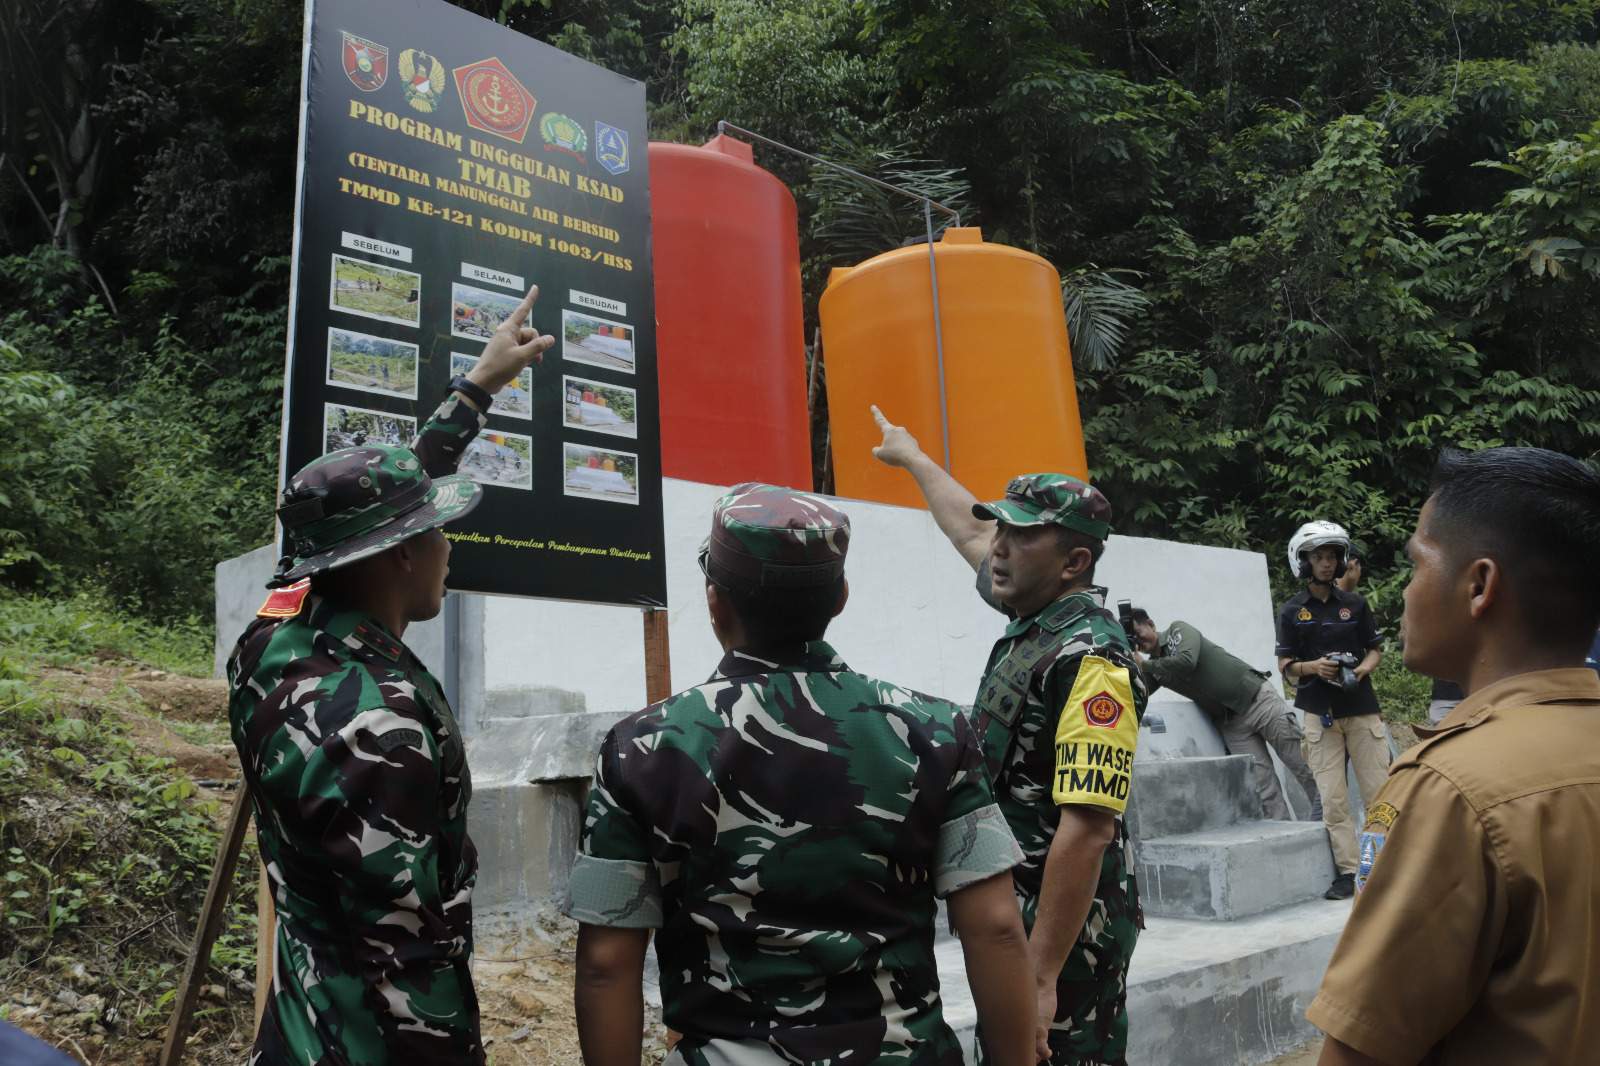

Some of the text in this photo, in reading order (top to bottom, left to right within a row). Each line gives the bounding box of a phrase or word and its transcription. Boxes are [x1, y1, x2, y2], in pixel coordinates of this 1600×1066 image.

[349, 99, 624, 204] PROGRAM UNGGULAN KSAD
[457, 157, 532, 199] TMAB
[348, 151, 620, 244] (TENTARA MANUNGGAL AIR BERSIH)
[338, 176, 633, 272] TMMD KE-121 KODIM 1003/HSS
[353, 238, 400, 257] SEBELUM
[473, 268, 512, 286] SELAMA
[577, 294, 619, 312] SESUDAH
[1056, 742, 1134, 774] TIM WASE
[1057, 768, 1130, 801] TMMD
